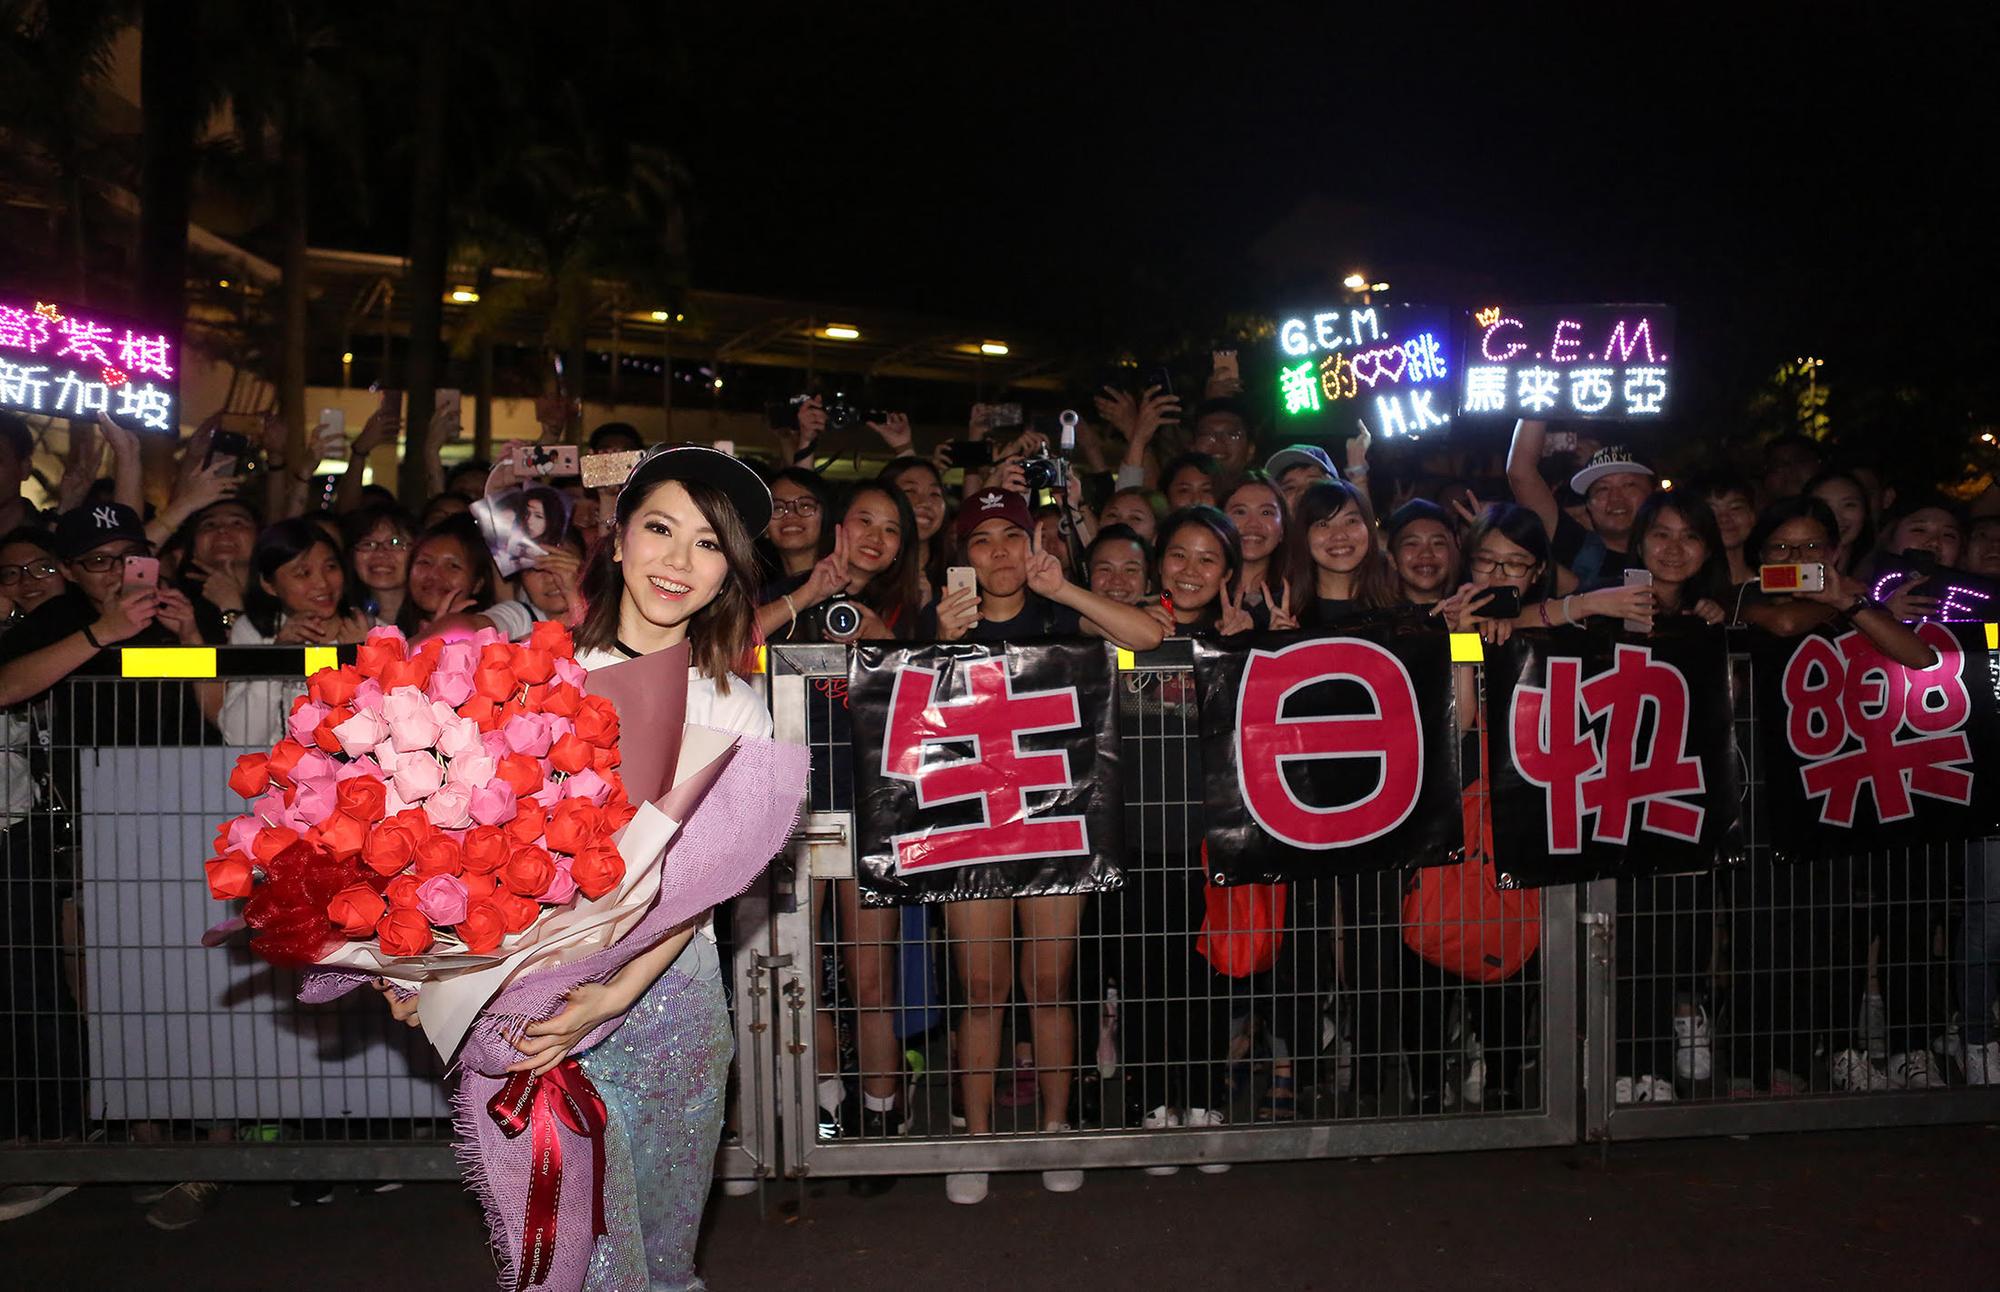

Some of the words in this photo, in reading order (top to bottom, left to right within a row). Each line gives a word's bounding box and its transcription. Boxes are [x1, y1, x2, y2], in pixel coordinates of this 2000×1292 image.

[1281, 308, 1389, 356] G.E.M.
[1482, 317, 1667, 363] G.E.M.
[0, 357, 172, 430] 新加坡
[1376, 389, 1450, 438] H.K.
[1464, 365, 1667, 415] 馬來西亞
[92, 506, 120, 529] NY
[879, 652, 1090, 876] 生
[1233, 635, 1425, 851] 日
[1510, 642, 1708, 856] 快
[1782, 619, 1975, 829] 樂
[542, 1147, 552, 1176] Today
